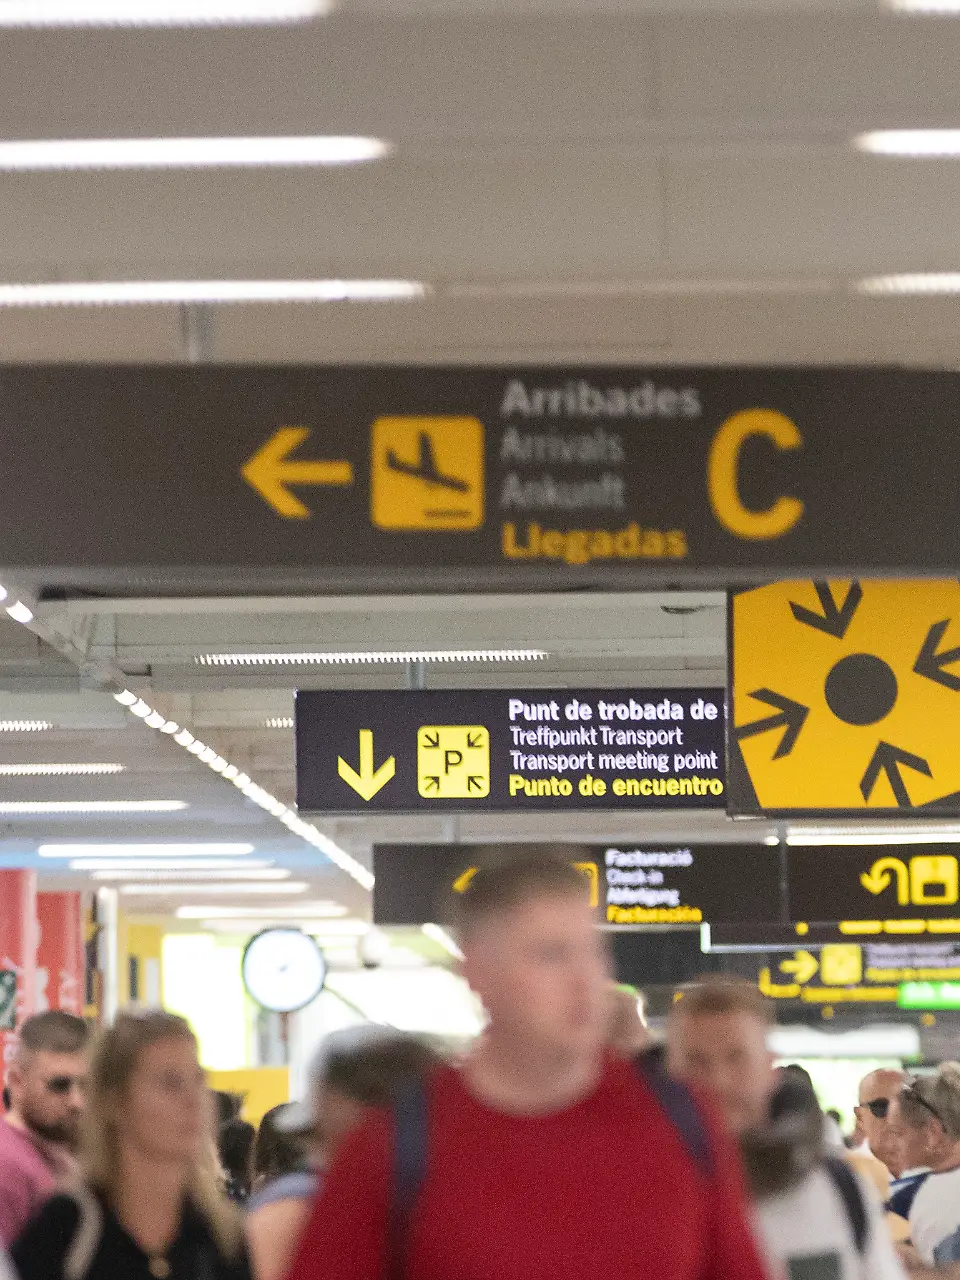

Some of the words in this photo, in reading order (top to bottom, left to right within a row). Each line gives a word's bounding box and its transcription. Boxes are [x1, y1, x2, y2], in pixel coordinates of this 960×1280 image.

[502, 379, 700, 418] Arribades
[708, 408, 804, 540] C
[503, 521, 687, 565] Llegadas
[508, 698, 560, 721] Punt
[565, 698, 593, 721] de
[598, 698, 685, 721] trobada
[690, 698, 719, 721] de
[509, 725, 598, 748] Treffpunkt
[599, 724, 684, 746] Transport
[443, 749, 464, 775] P
[510, 750, 595, 772] Transport
[599, 749, 670, 772] meeting
[674, 749, 719, 772] point
[509, 773, 573, 796] Punto
[578, 773, 607, 796] de
[612, 775, 724, 796] encuentro
